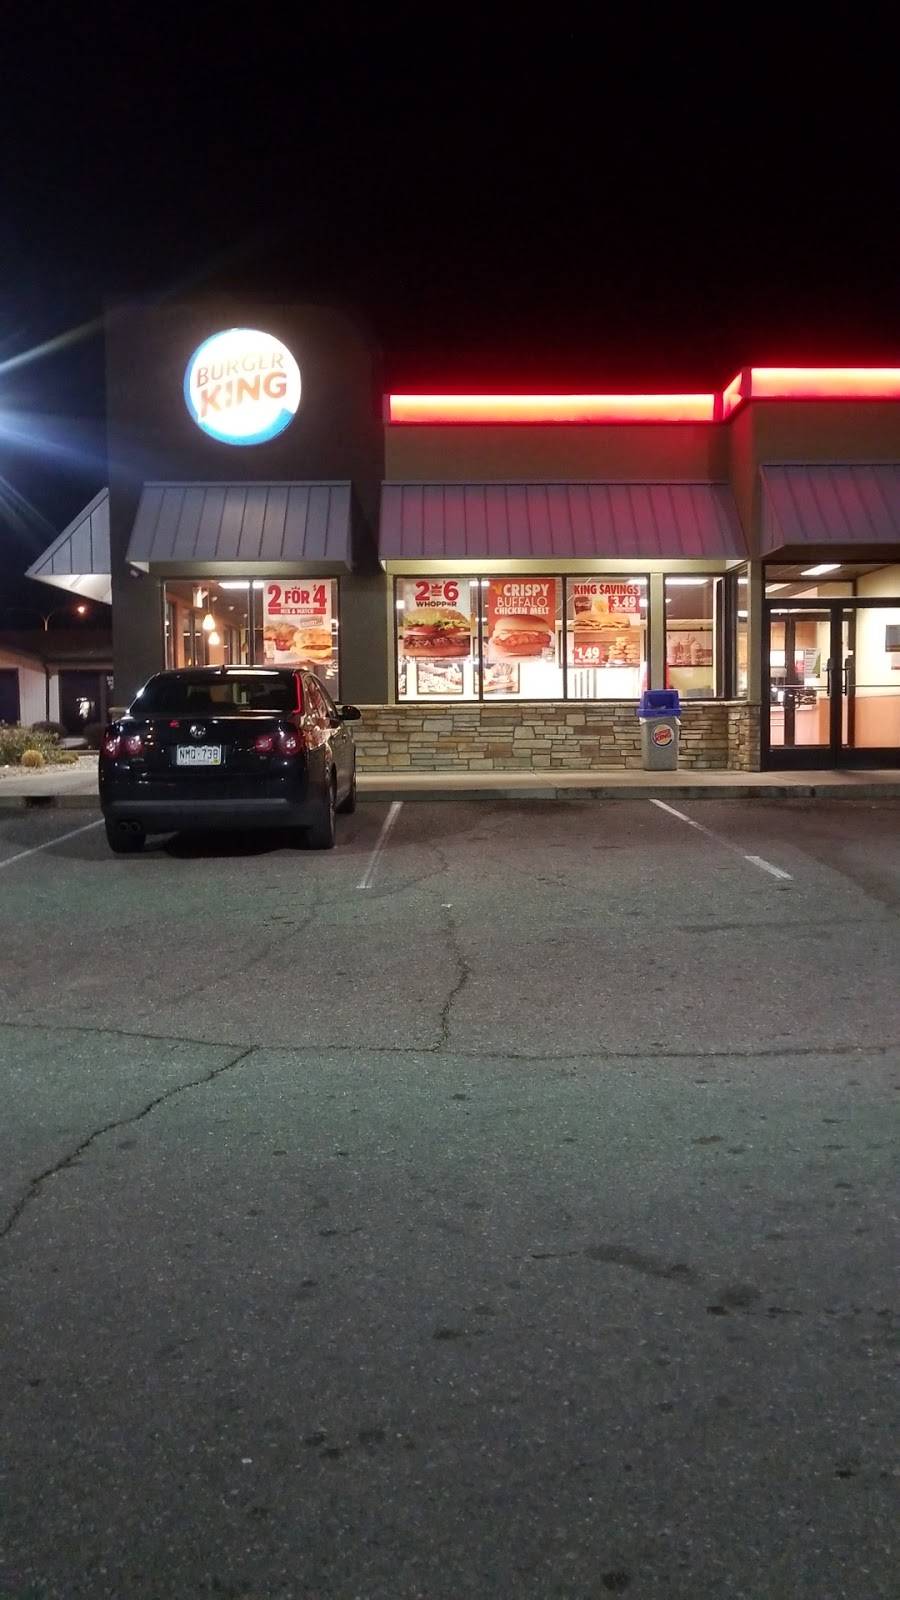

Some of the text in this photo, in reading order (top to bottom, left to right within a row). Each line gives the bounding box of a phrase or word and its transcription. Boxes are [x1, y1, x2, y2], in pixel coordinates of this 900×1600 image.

[196, 352, 285, 388] BURGER
[200, 371, 288, 418] KING
[268, 585, 282, 607] 2
[284, 590, 310, 604] FOR
[415, 581, 430, 601] 2
[503, 583, 549, 597] CRISPY
[574, 584, 597, 595] KING
[497, 596, 548, 607] BUFFALO
[494, 607, 550, 615] CHICKEN MELT
